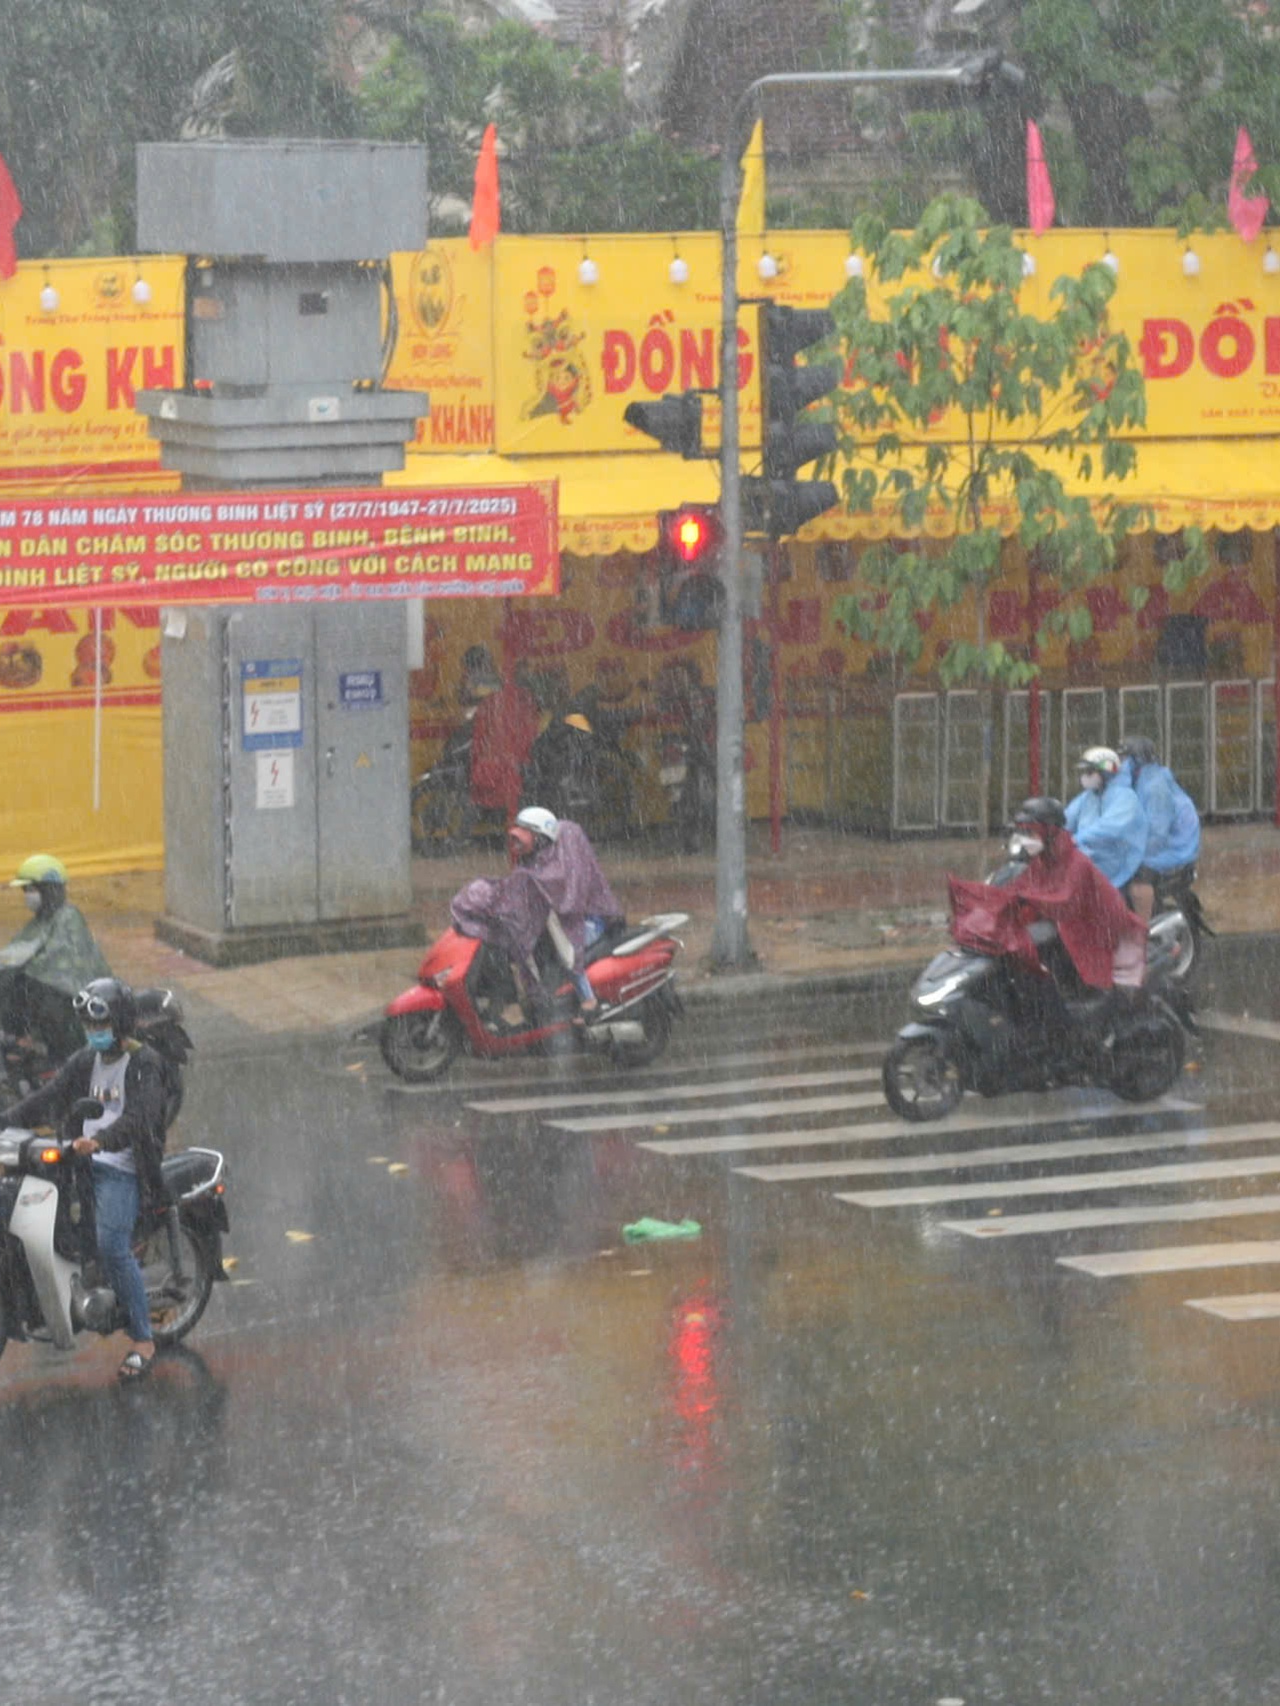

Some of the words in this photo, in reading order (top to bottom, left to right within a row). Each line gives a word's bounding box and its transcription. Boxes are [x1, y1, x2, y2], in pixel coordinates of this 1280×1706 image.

[431, 395, 495, 444] KHÁNH
[22, 509, 44, 526] 78
[48, 505, 88, 526] NĂM
[143, 504, 212, 523] THƯƠNG
[217, 503, 259, 522] BINH
[263, 500, 299, 524] LIỆT
[330, 496, 517, 521] (27/7/1947-27/7/2025)
[20, 533, 68, 557] DÂN
[76, 530, 147, 556] CHĂM
[155, 530, 202, 554] SÓC
[210, 530, 305, 552] THƯƠNG
[384, 524, 446, 547] BỆNH
[54, 562, 104, 588] LIỆT
[155, 558, 229, 582] NGƯỜI
[276, 555, 341, 577] CÔNG
[349, 552, 387, 575] VỚI
[395, 551, 458, 574] CÁCH
[465, 553, 533, 576] MẠNG
